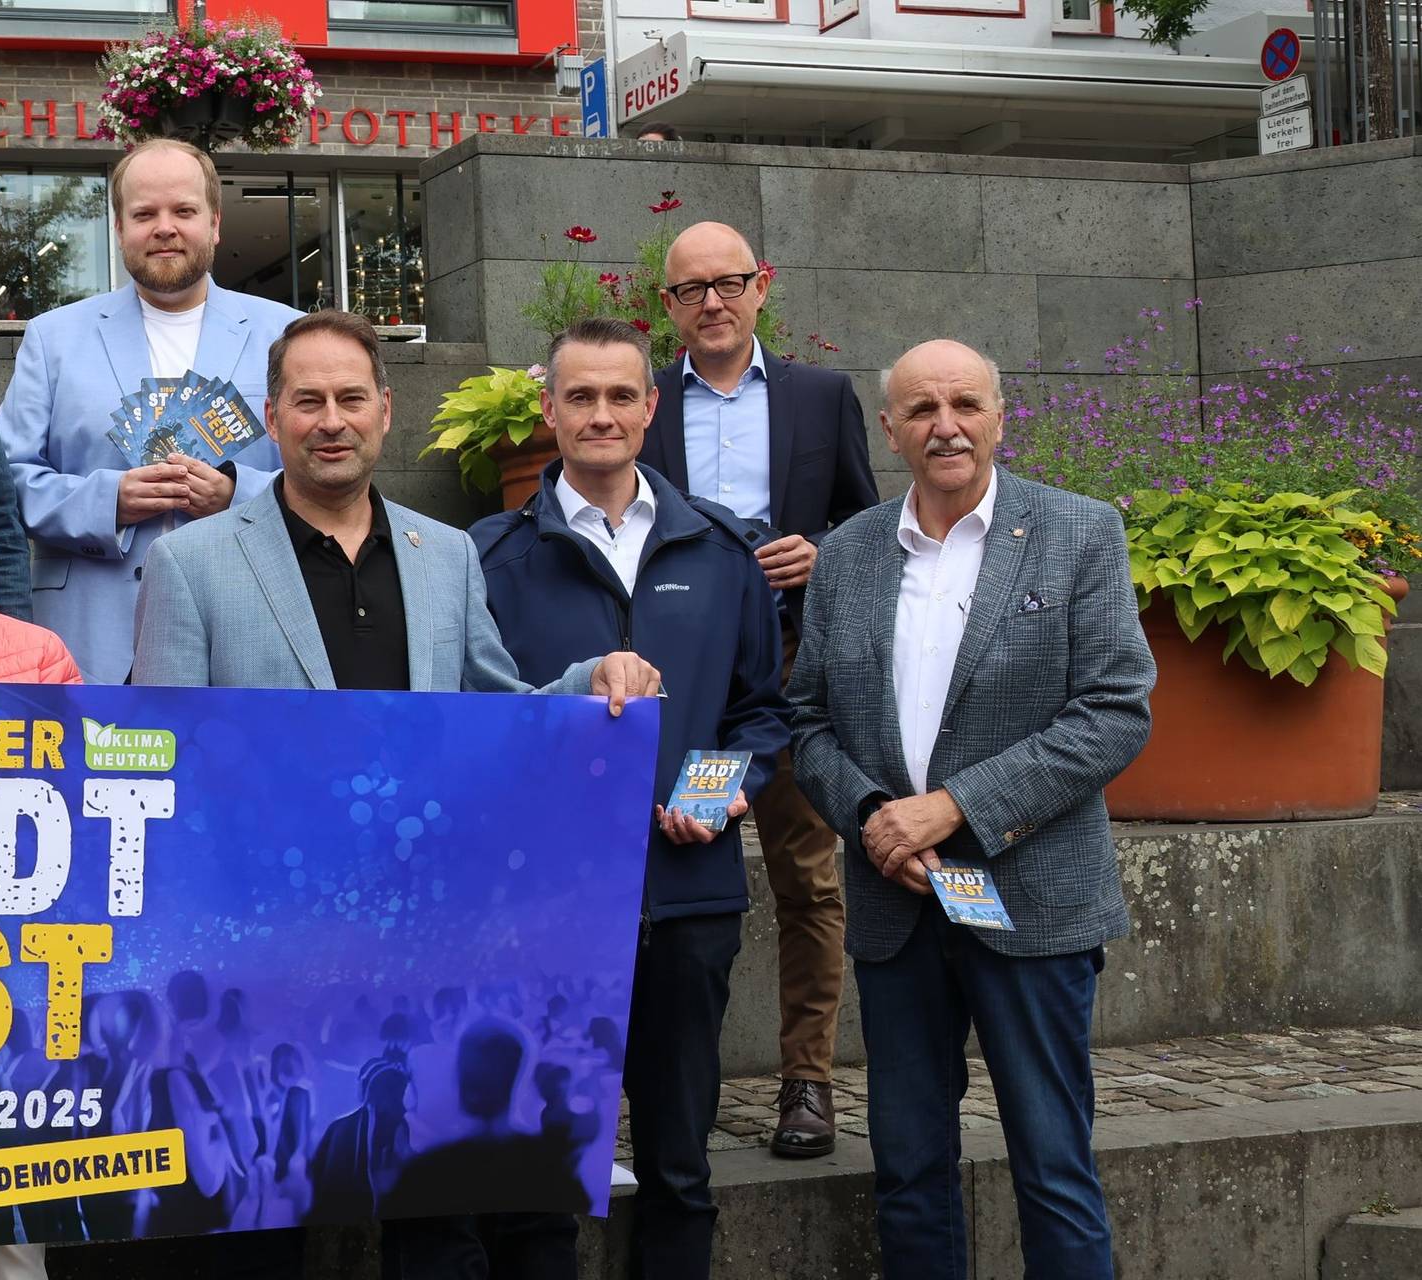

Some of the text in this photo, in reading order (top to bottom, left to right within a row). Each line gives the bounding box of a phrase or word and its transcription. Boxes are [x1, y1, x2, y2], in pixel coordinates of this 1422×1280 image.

[623, 52, 677, 87] BRILLEN
[584, 71, 595, 107] P
[625, 68, 679, 117] FUCHS
[1282, 84, 1296, 95] dem
[309, 107, 571, 148] POTHEKE
[1267, 115, 1300, 128] Liefer-
[1265, 125, 1304, 140] verkehr
[1277, 139, 1294, 149] frei
[211, 395, 250, 442] STADT
[202, 408, 235, 445] FEST
[112, 733, 170, 748] KLIMA-
[93, 752, 169, 768] NEUTRAL
[686, 763, 740, 777] STADT
[687, 776, 730, 790] FEST
[932, 871, 985, 886] STADT
[944, 882, 984, 897] FEST
